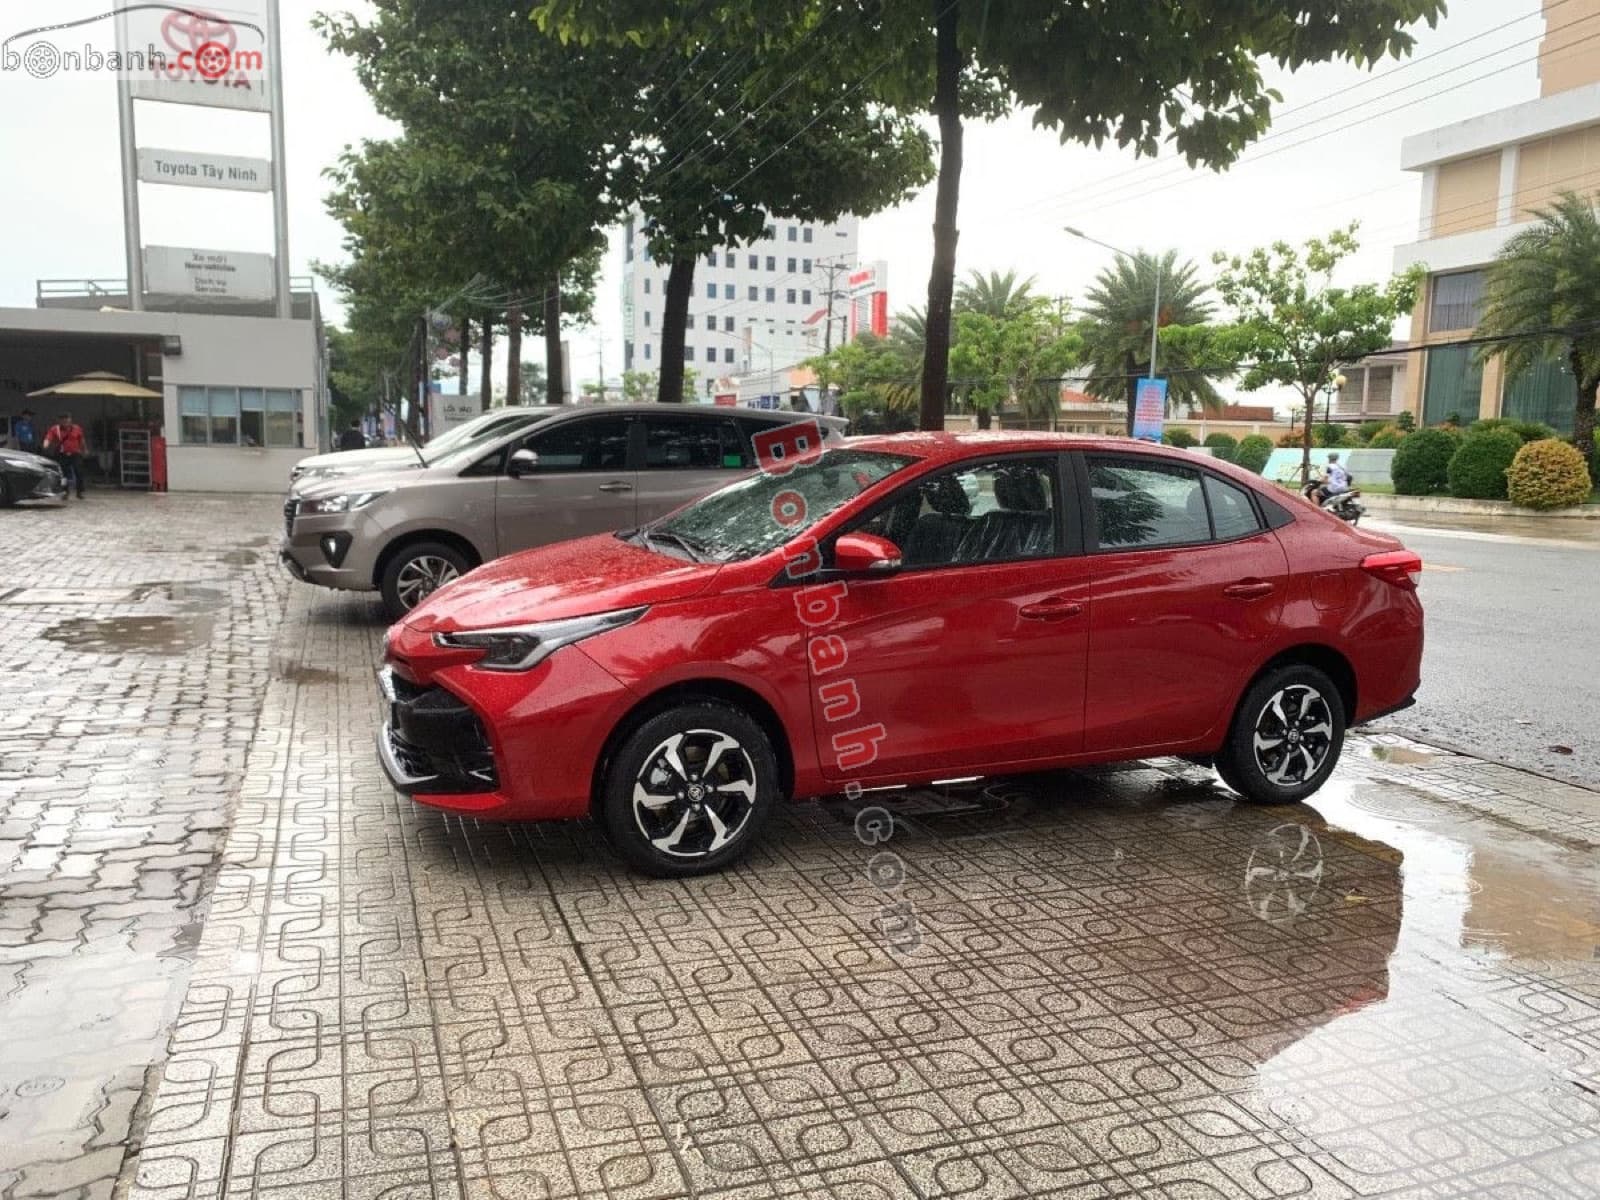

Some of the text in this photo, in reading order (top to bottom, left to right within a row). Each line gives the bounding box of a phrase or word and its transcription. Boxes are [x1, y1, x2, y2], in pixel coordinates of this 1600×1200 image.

[154, 160, 257, 181] Toyota Tây Ninh
